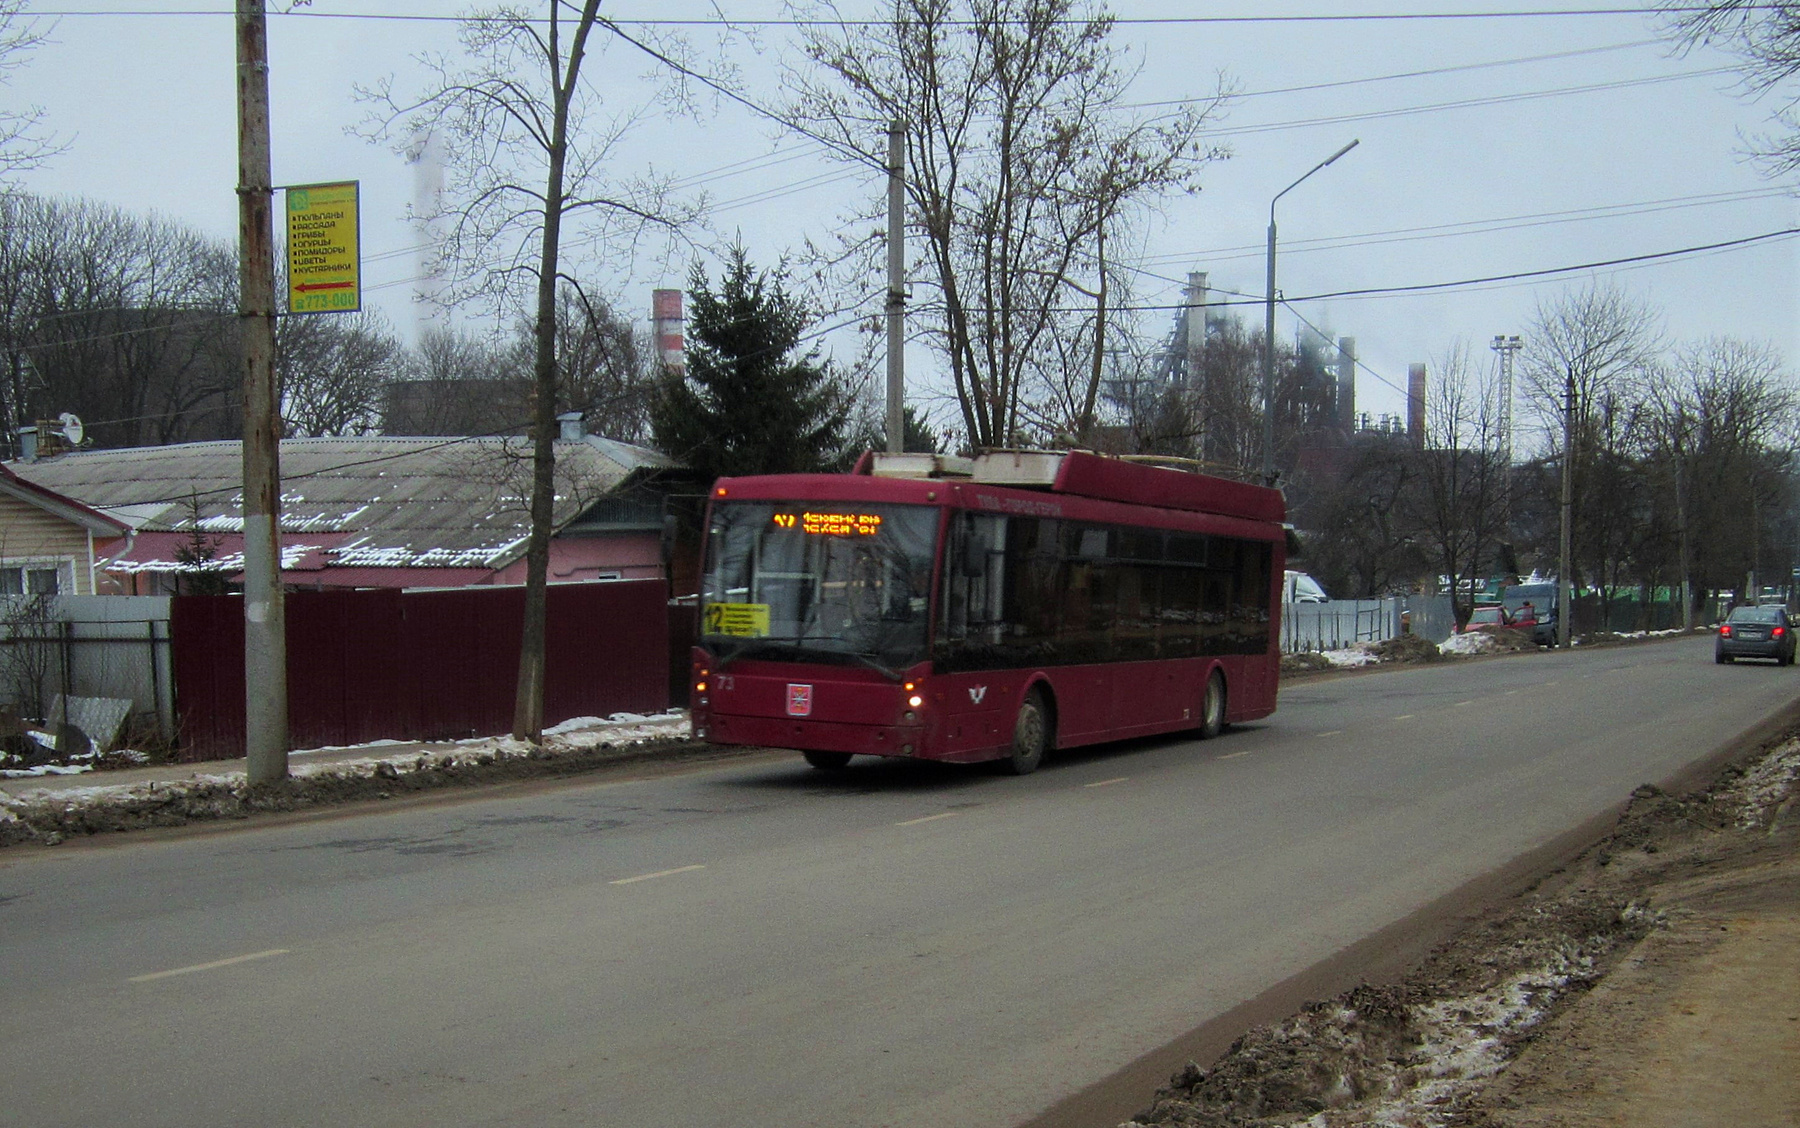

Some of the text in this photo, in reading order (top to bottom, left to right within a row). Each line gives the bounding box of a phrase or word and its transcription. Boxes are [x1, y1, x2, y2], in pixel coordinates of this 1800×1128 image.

[297, 212, 343, 221] ТЮЛЬПАНЫ
[297, 221, 336, 231] РАССАДА
[297, 230, 326, 239] ГРИБЫ
[298, 239, 331, 248] ОГУРЦЫ
[298, 246, 346, 257] ПОМИДОРЫ
[298, 256, 327, 265] ЦВЕТЫ
[298, 264, 351, 273] КУСТАРНИКИ
[305, 292, 355, 309] 773-000
[718, 676, 735, 690] 73
